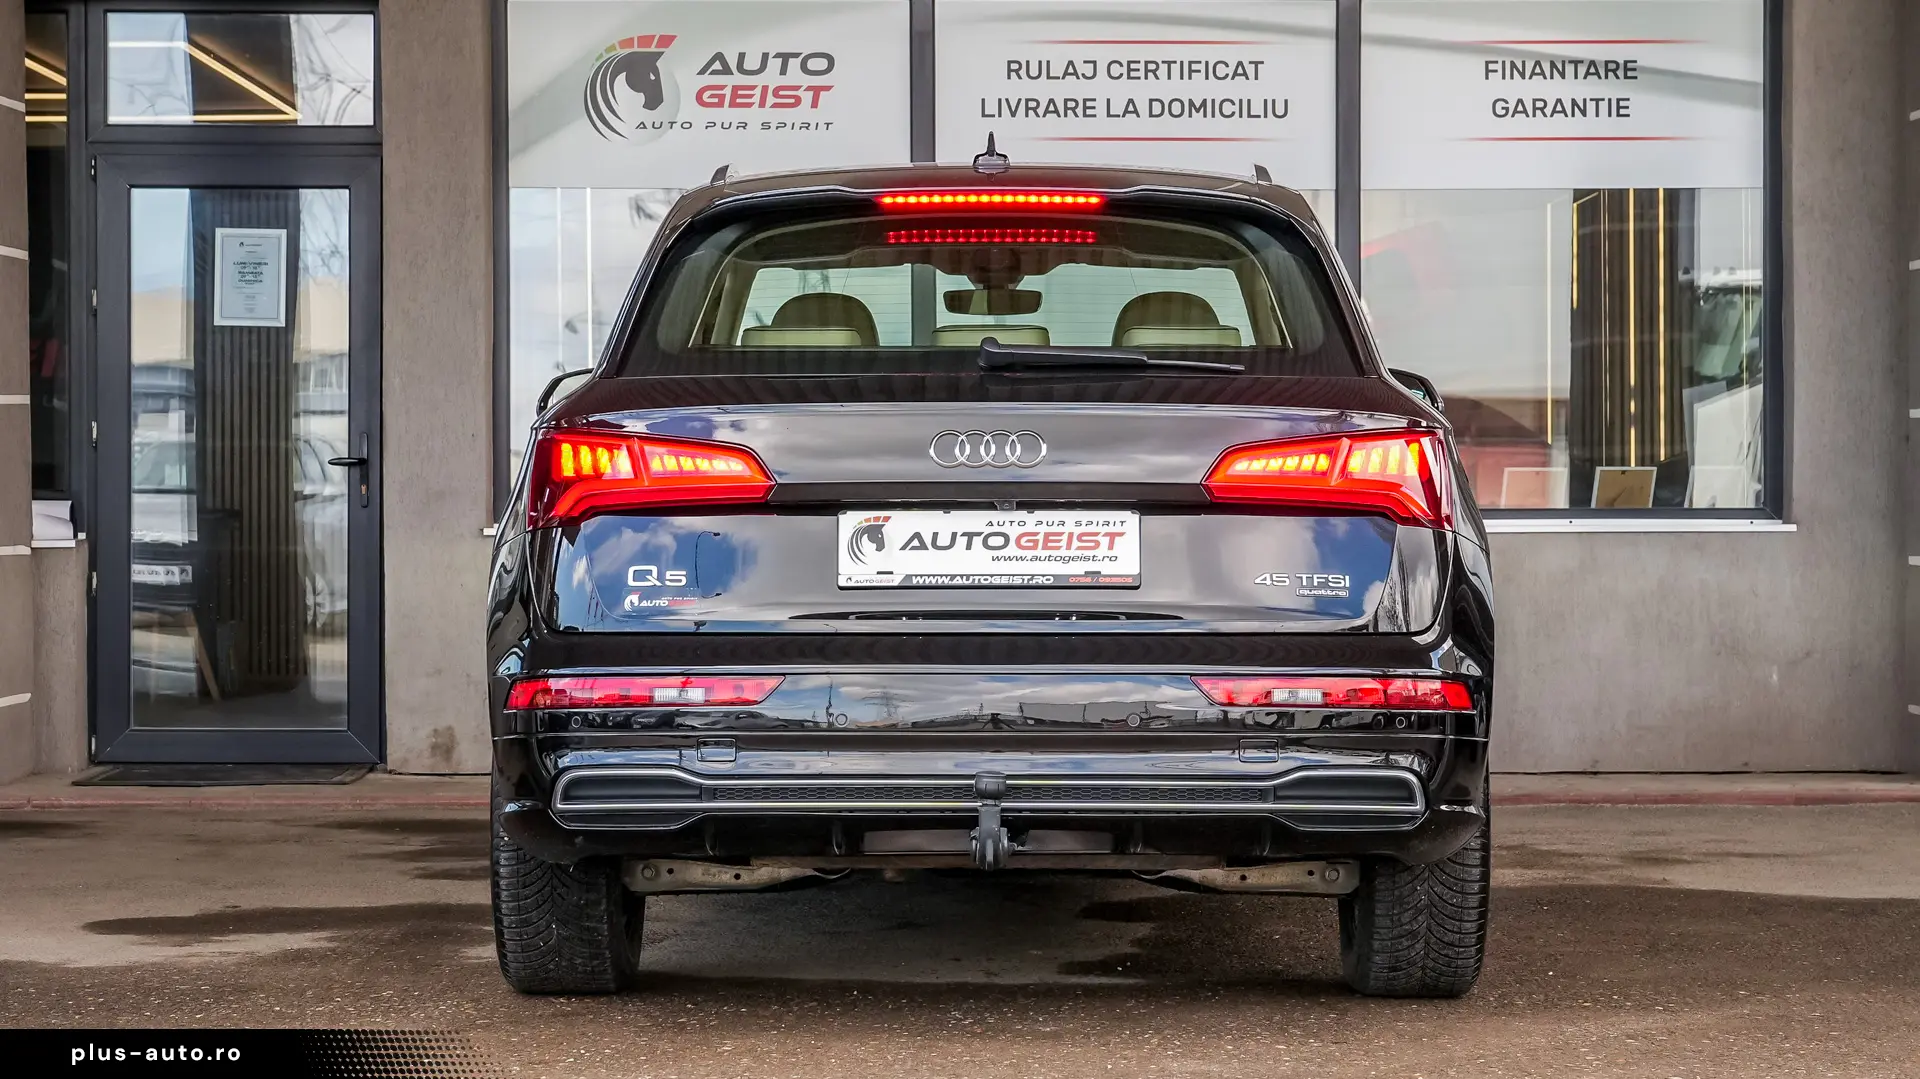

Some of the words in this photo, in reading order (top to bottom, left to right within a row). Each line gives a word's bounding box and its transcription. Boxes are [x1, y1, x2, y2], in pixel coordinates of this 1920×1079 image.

[696, 51, 836, 76] AUTO
[1006, 59, 1098, 80] RULAJ
[1106, 59, 1265, 81] CERTIFICAT
[1484, 60, 1638, 80] FINANTARE
[695, 84, 835, 109] GEIST
[980, 97, 1097, 119] LIVRARE
[1106, 97, 1141, 119] LA
[1148, 98, 1289, 119] DOMICILIU
[1491, 97, 1631, 118] GARANTIE
[635, 121, 693, 131] AUTO
[704, 121, 748, 131] PUR
[759, 121, 834, 131] SPIRIT
[899, 531, 1126, 551] AUTOGEIST
[991, 553, 1118, 564] www.autogeist.ro
[627, 565, 687, 587] Q5
[911, 575, 1054, 584] WWW.AUTOGEIST.RO
[1254, 572, 1290, 586] 45
[1295, 573, 1350, 588] TFSI
[1298, 589, 1347, 597] quattro
